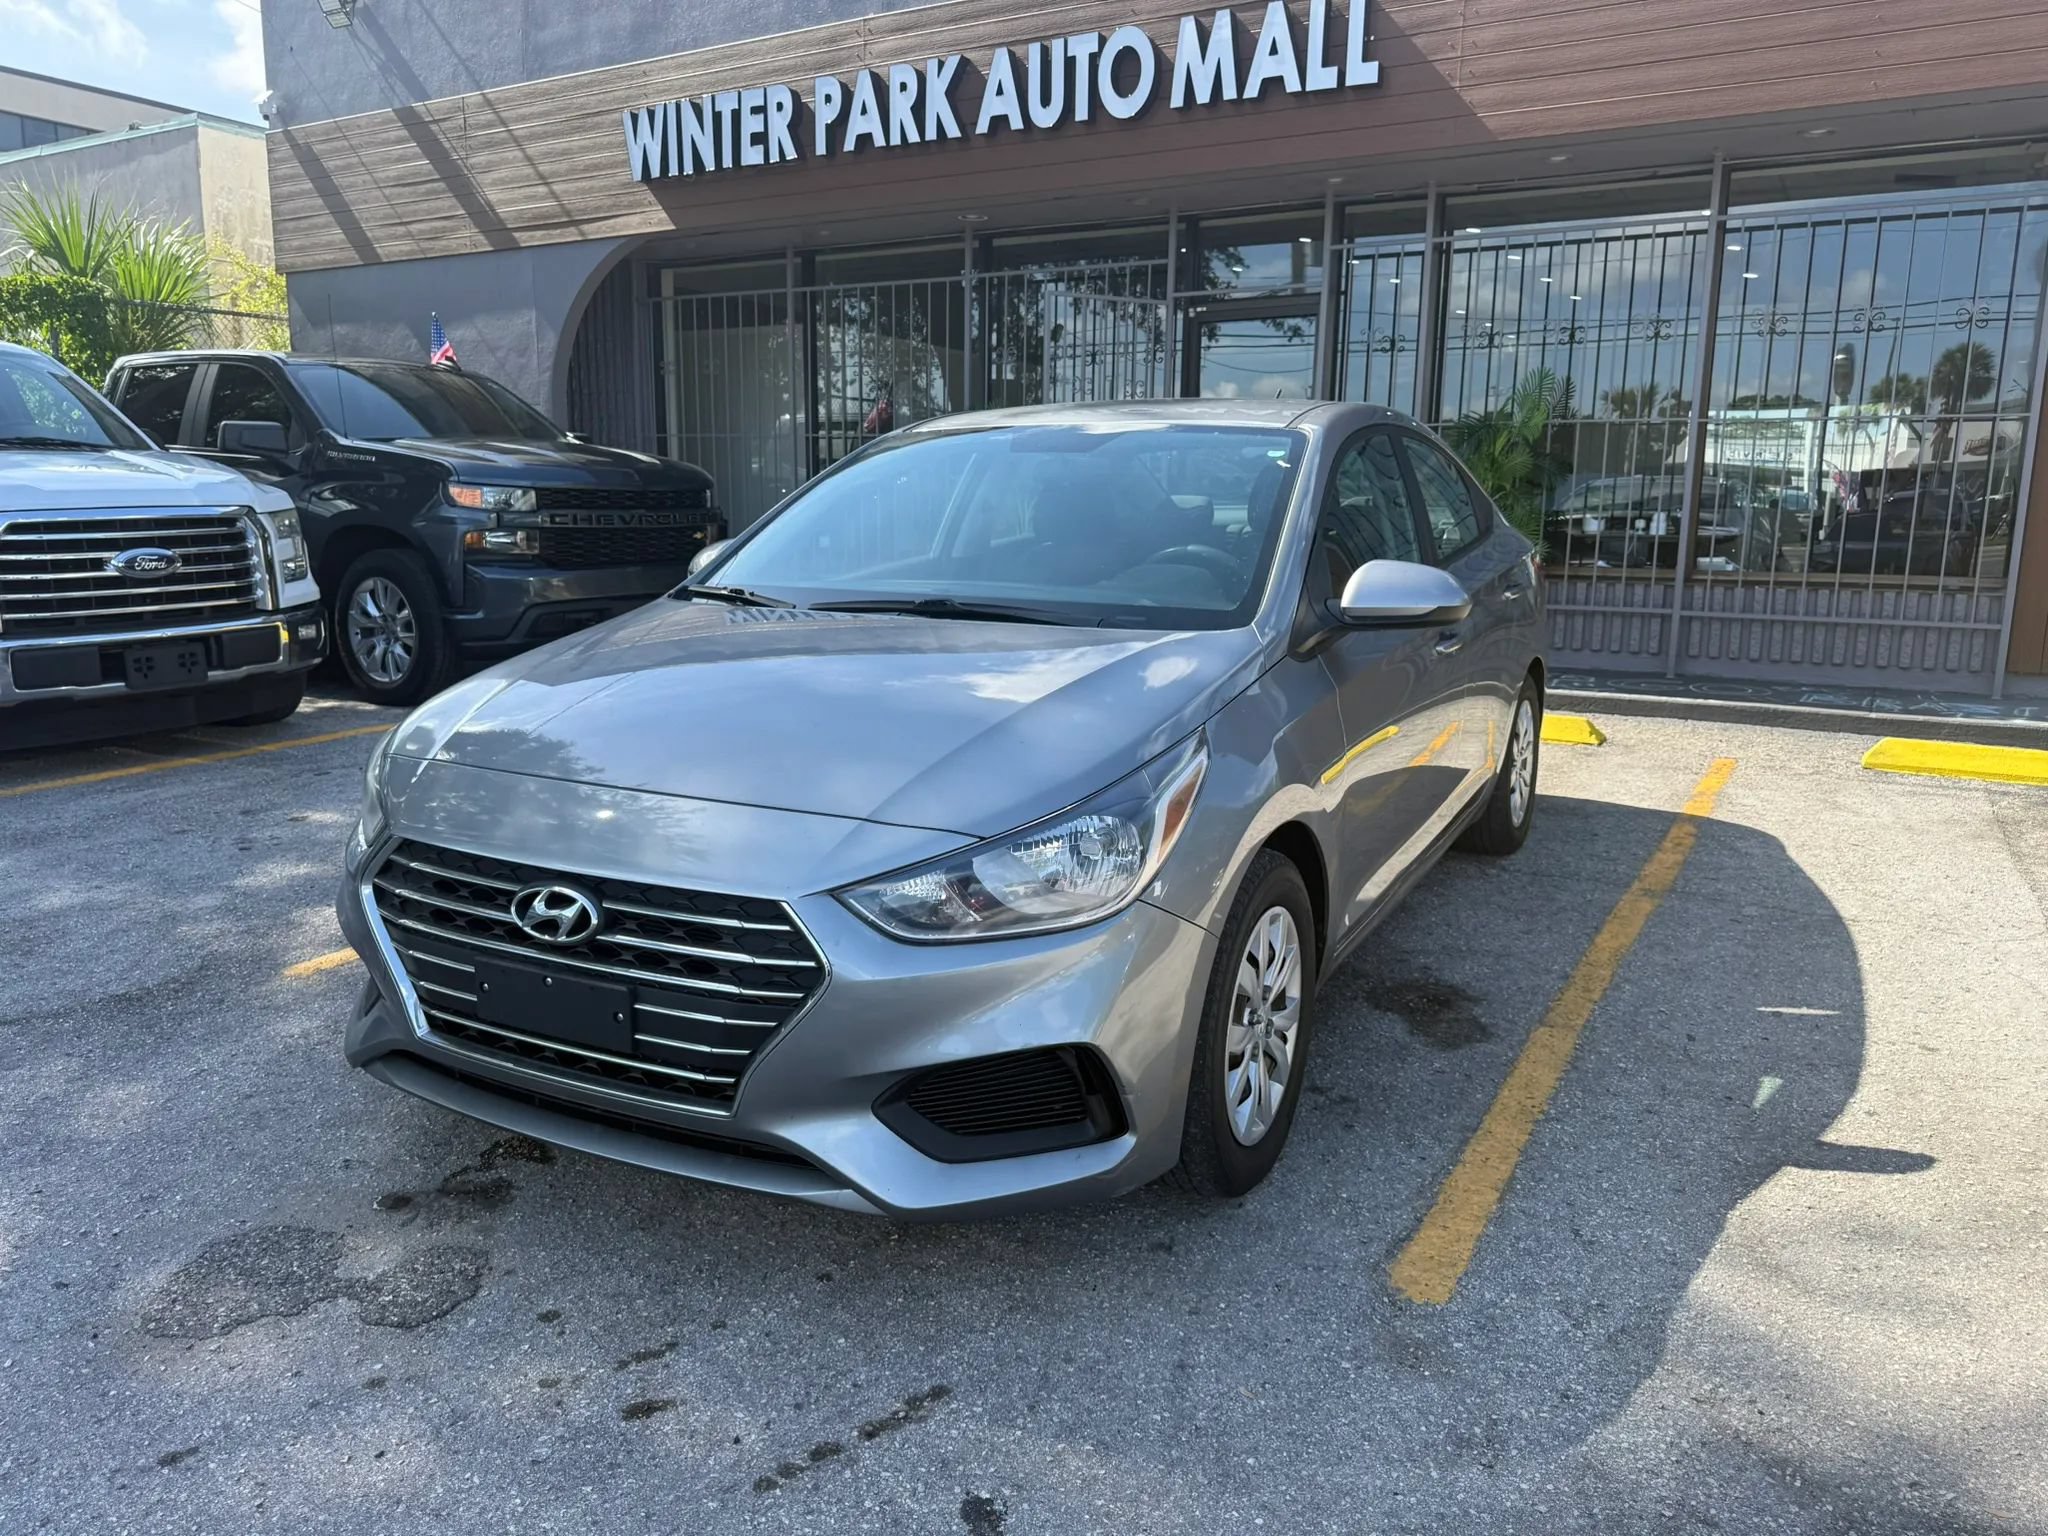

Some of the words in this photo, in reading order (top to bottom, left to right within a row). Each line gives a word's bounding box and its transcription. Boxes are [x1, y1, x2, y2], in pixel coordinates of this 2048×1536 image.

[621, 84, 799, 182] WINTER
[814, 55, 963, 156] PARK
[974, 25, 1156, 135] AUTO
[1169, 0, 1380, 109] MALL
[134, 555, 168, 571] Ford
